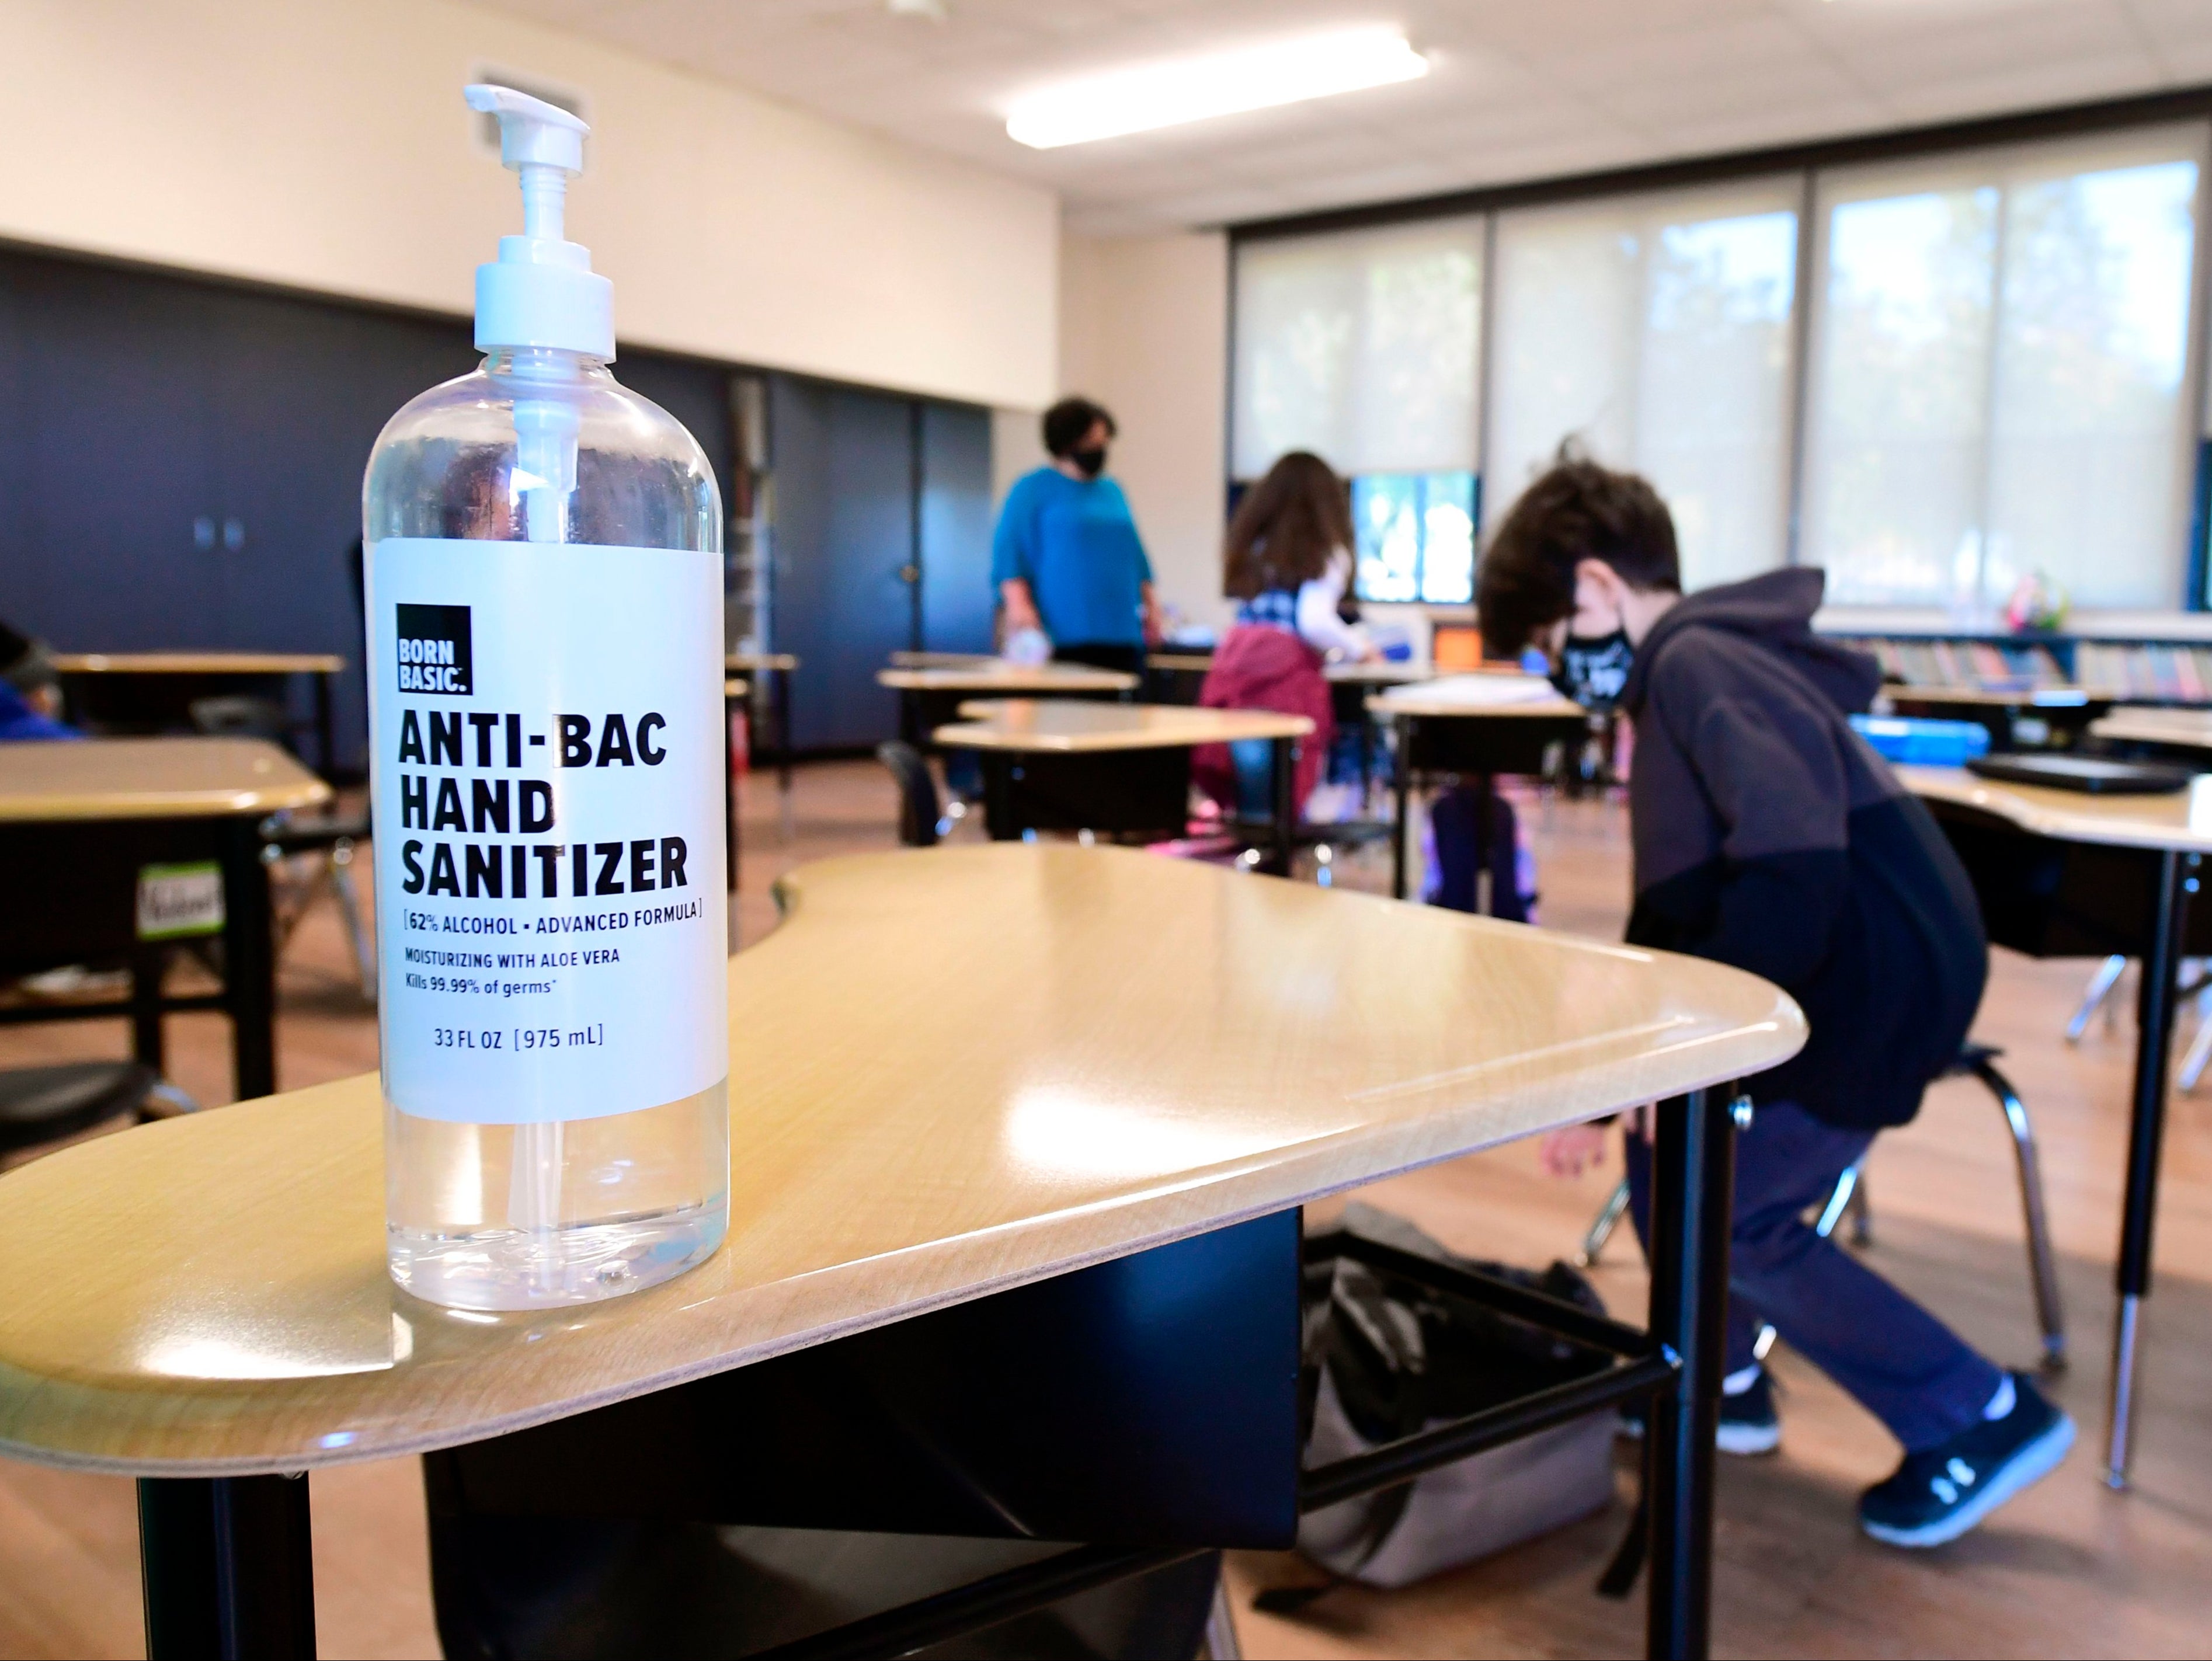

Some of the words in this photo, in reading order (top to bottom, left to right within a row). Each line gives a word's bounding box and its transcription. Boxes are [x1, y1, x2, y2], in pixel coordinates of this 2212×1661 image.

[398, 638, 455, 665] BORN
[398, 709, 667, 768] ANTI-BAC
[400, 774, 557, 834] HAND
[401, 836, 688, 899] SANITIZER
[404, 908, 439, 932] [62%
[442, 915, 518, 935] ALCOHOL
[535, 912, 629, 934] ADVANCED
[634, 897, 702, 927] FORMULA]
[405, 947, 493, 969] MOISTURIZING
[497, 953, 535, 969] WITH
[540, 952, 578, 968] ALOE
[582, 948, 620, 965] VERA
[405, 972, 427, 990] Kills
[430, 976, 480, 994] 99.99%
[484, 979, 499, 994] of
[434, 1028, 454, 1047] 33
[458, 1030, 476, 1049] FL
[481, 1030, 503, 1049] OZ
[514, 1028, 561, 1052] [975
[568, 1022, 603, 1047] mL]
